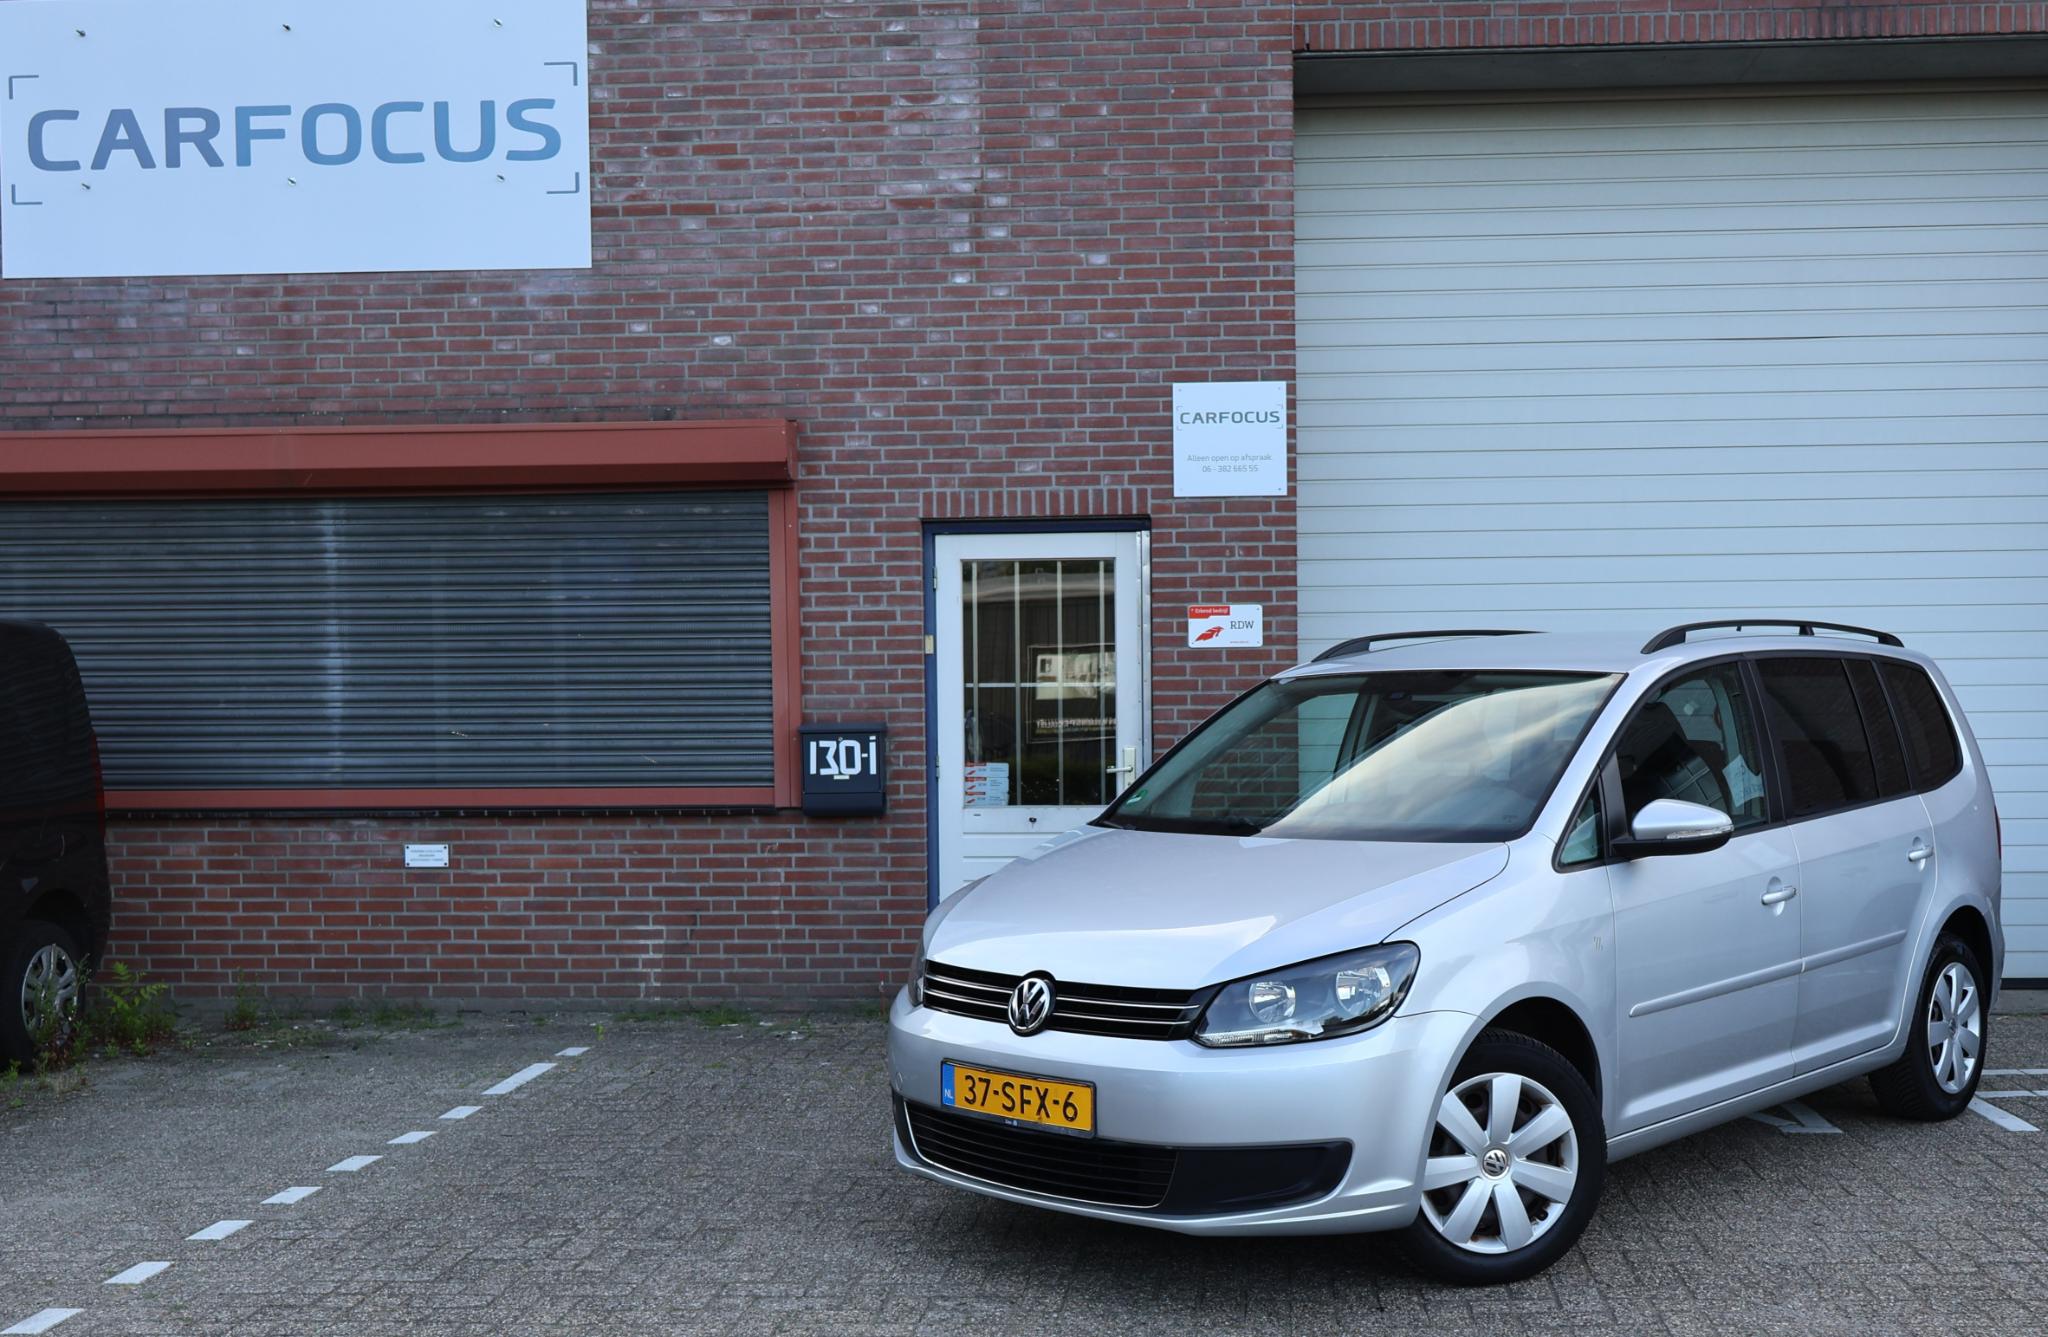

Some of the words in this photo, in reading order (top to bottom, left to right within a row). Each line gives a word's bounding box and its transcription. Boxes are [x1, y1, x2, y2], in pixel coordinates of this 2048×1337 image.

[27, 98, 562, 172] CARFOCUS
[1180, 411, 1280, 424] CARFOCUS
[1187, 454, 1210, 462] Alleen
[1211, 455, 1228, 463] open
[1241, 454, 1272, 462] afspraak
[1230, 620, 1254, 630] RDW
[944, 1087, 954, 1099] NL
[963, 1074, 1079, 1123] 37-SFX-6
